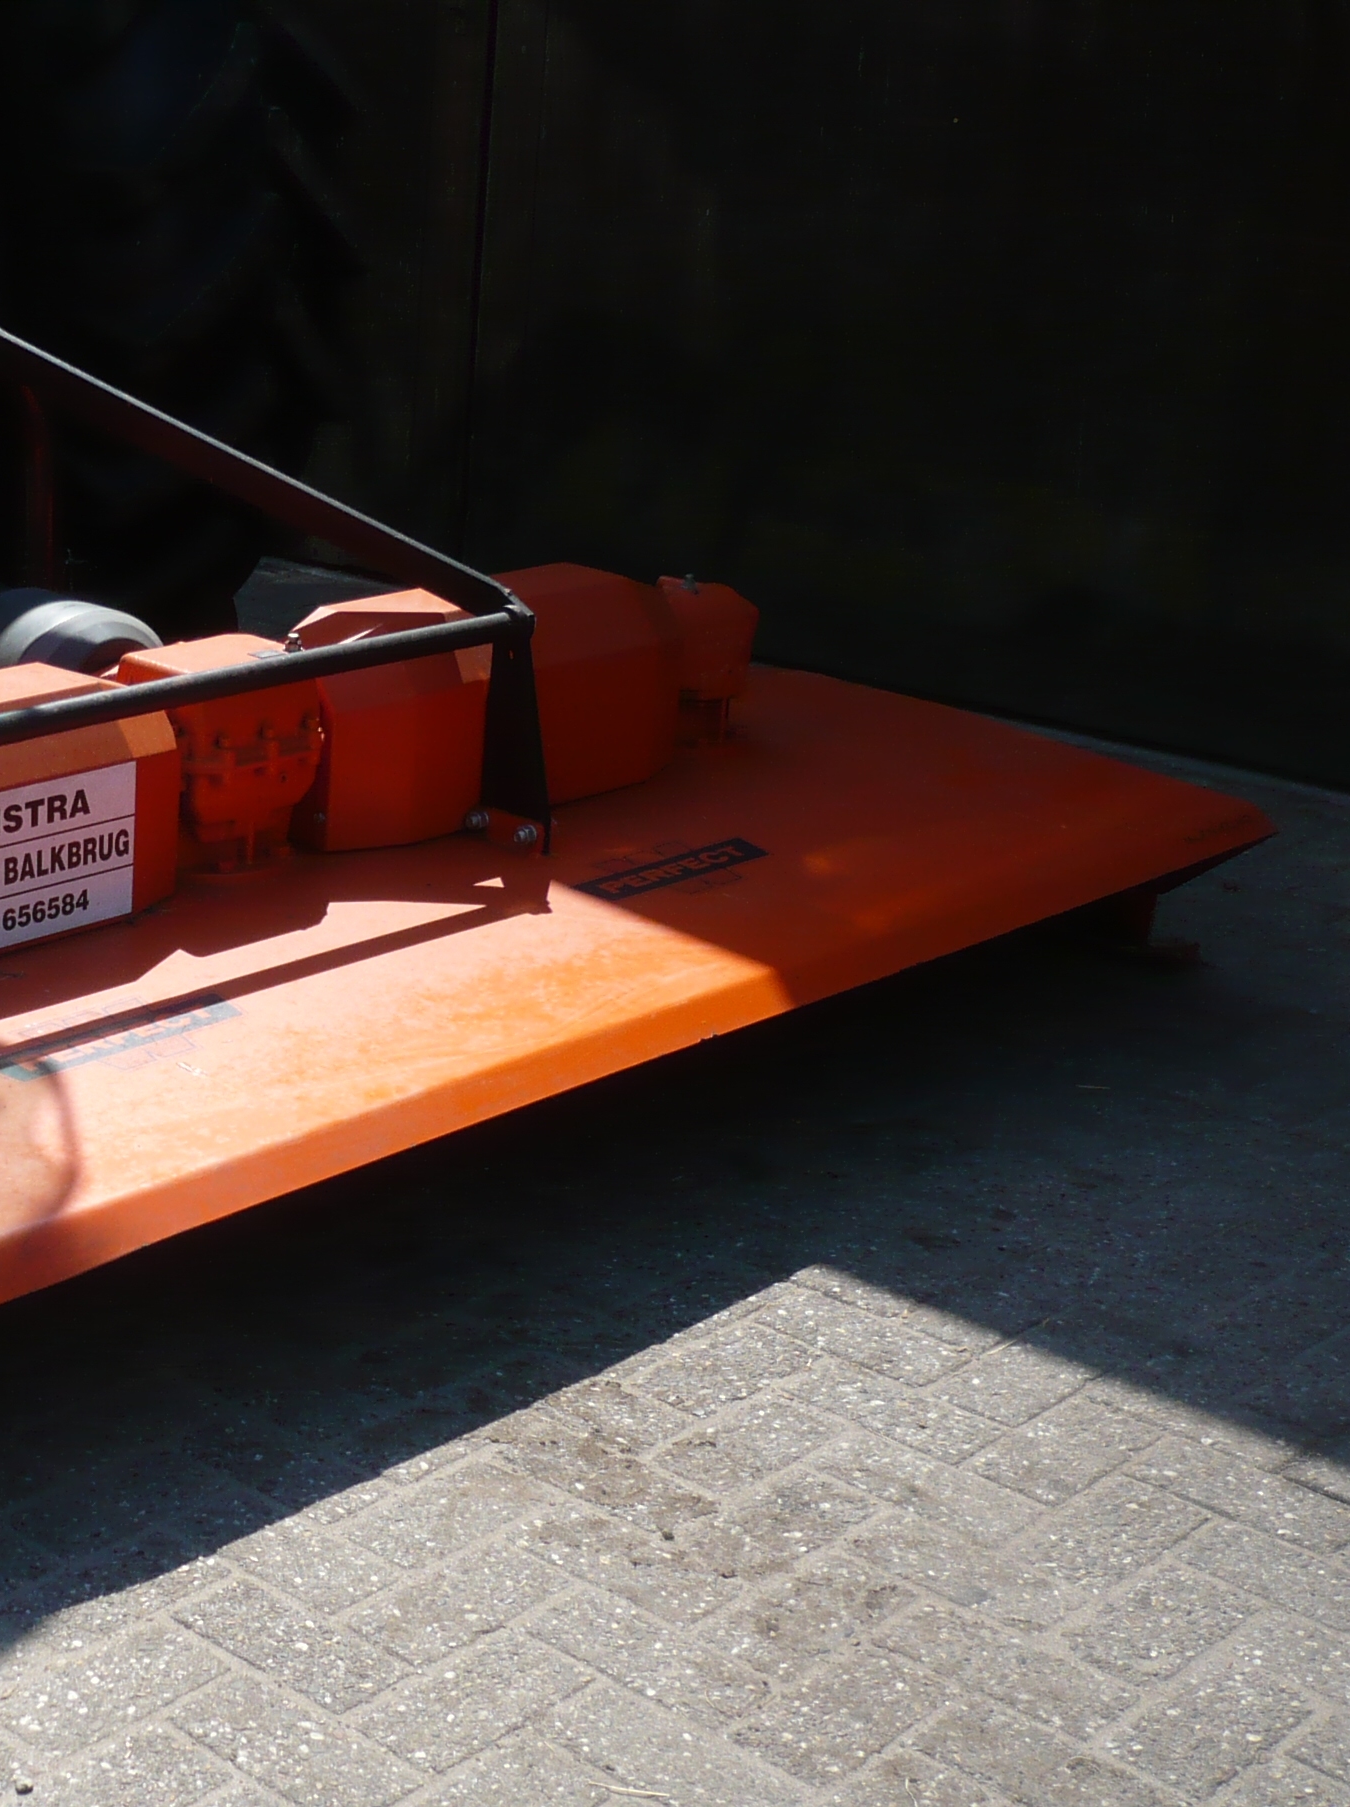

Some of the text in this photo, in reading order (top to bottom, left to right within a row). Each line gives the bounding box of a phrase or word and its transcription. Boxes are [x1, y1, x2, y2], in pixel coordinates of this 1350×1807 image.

[4, 828, 130, 886] BALKBRUG
[598, 844, 746, 895] PERFECT
[1, 888, 90, 932] 656584
